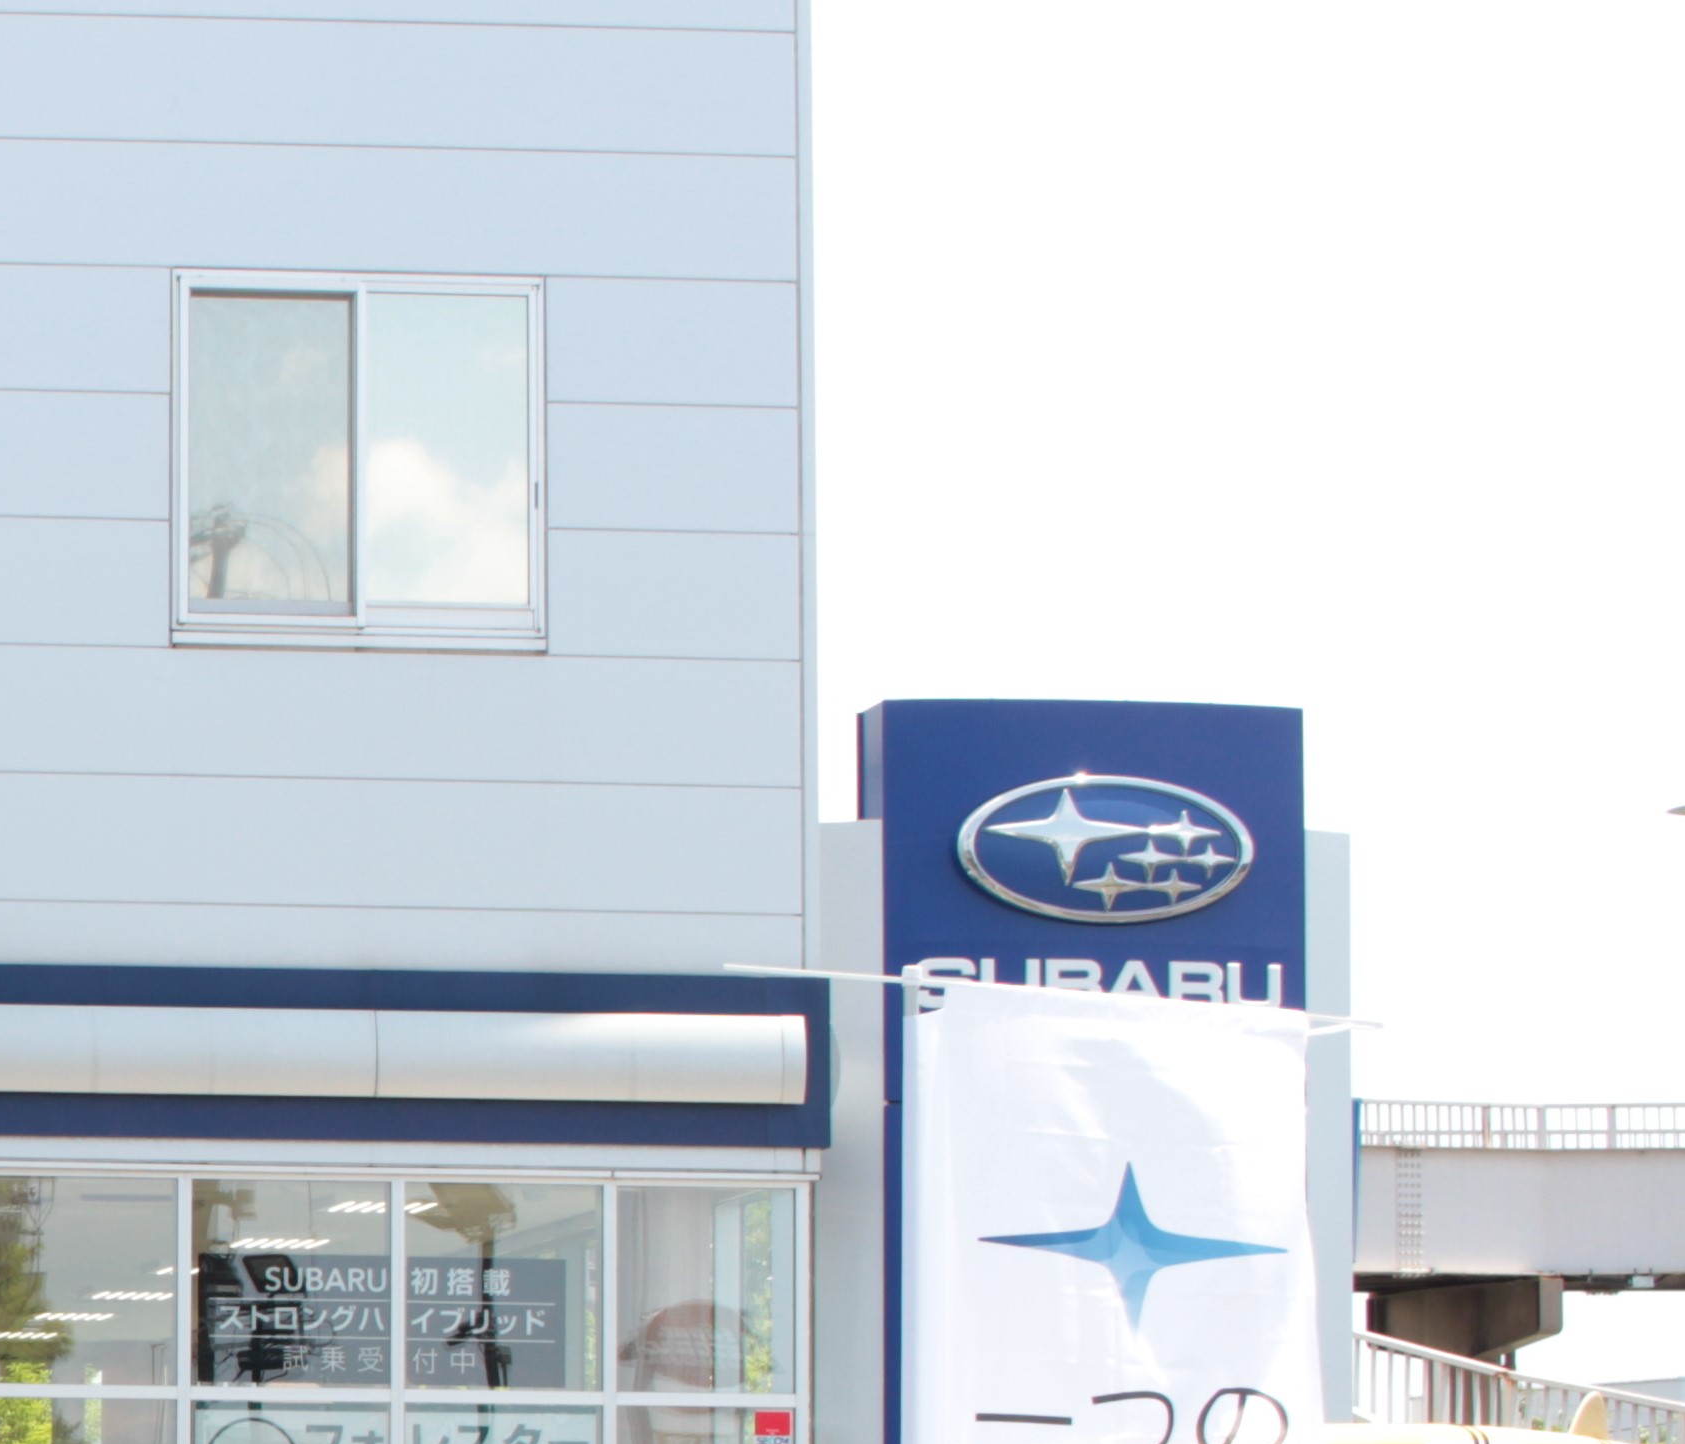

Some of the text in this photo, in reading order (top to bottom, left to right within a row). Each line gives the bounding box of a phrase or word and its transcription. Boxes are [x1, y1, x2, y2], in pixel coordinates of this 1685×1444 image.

[264, 1267, 388, 1293] SUBARU
[219, 1304, 546, 1336] ストロングハイブリッド
[282, 1345, 478, 1375] 試乗受付中
